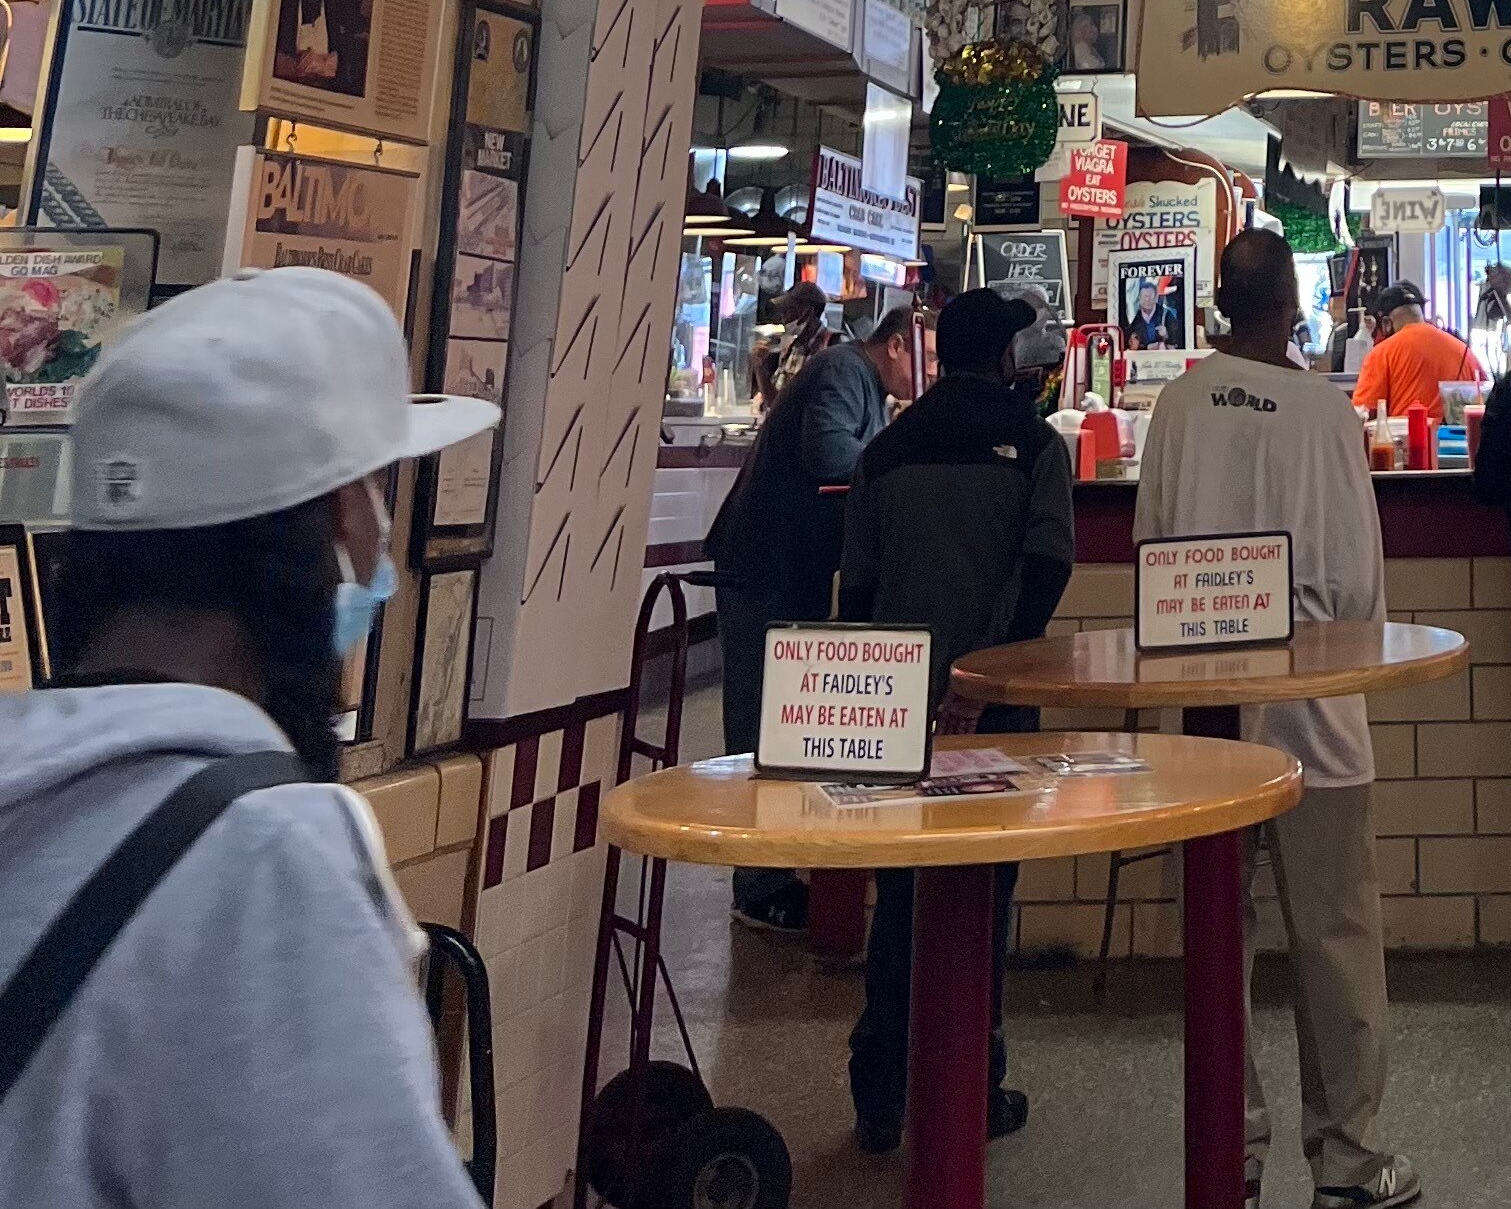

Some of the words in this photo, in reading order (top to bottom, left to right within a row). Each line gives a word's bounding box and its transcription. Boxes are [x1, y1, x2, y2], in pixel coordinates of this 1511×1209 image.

[1263, 35, 1466, 75] OYSTERS
[1075, 158, 1115, 175] VIAGRA
[1085, 174, 1103, 187] EAT
[1068, 186, 1117, 205] OYSTERS
[1149, 193, 1198, 208] Shucked
[34, 253, 62, 265] DISH
[64, 252, 100, 265] AWARD
[1001, 241, 1047, 258] ORDER
[31, 265, 58, 276] MAG
[1008, 263, 1043, 280] HERE
[1121, 263, 1183, 279] FOREVER
[24, 397, 68, 409] DISHES
[1146, 551, 1178, 566] ONLY
[1185, 548, 1224, 564] FOOD
[1231, 544, 1282, 561] BOUGHT
[1174, 574, 1188, 589] AT
[1196, 570, 1254, 588] FAIDLEY'S
[1156, 598, 1184, 614] MAY
[1191, 597, 1206, 612] BE
[1213, 594, 1249, 611] EATEN
[1253, 593, 1271, 610] AT
[1180, 622, 1206, 637] THIS
[1213, 618, 1249, 635] TABLE
[774, 640, 813, 661] ONLY
[817, 641, 858, 662] FOOD
[862, 643, 924, 664] BOUGHT
[800, 673, 819, 692] AT
[822, 673, 893, 695] FAIDLEY'S
[781, 704, 814, 725] MAY
[817, 705, 836, 726] BE
[839, 706, 885, 728] EATEN
[889, 708, 909, 729] AT
[803, 737, 835, 758] THIS
[839, 738, 883, 760] TABLE
